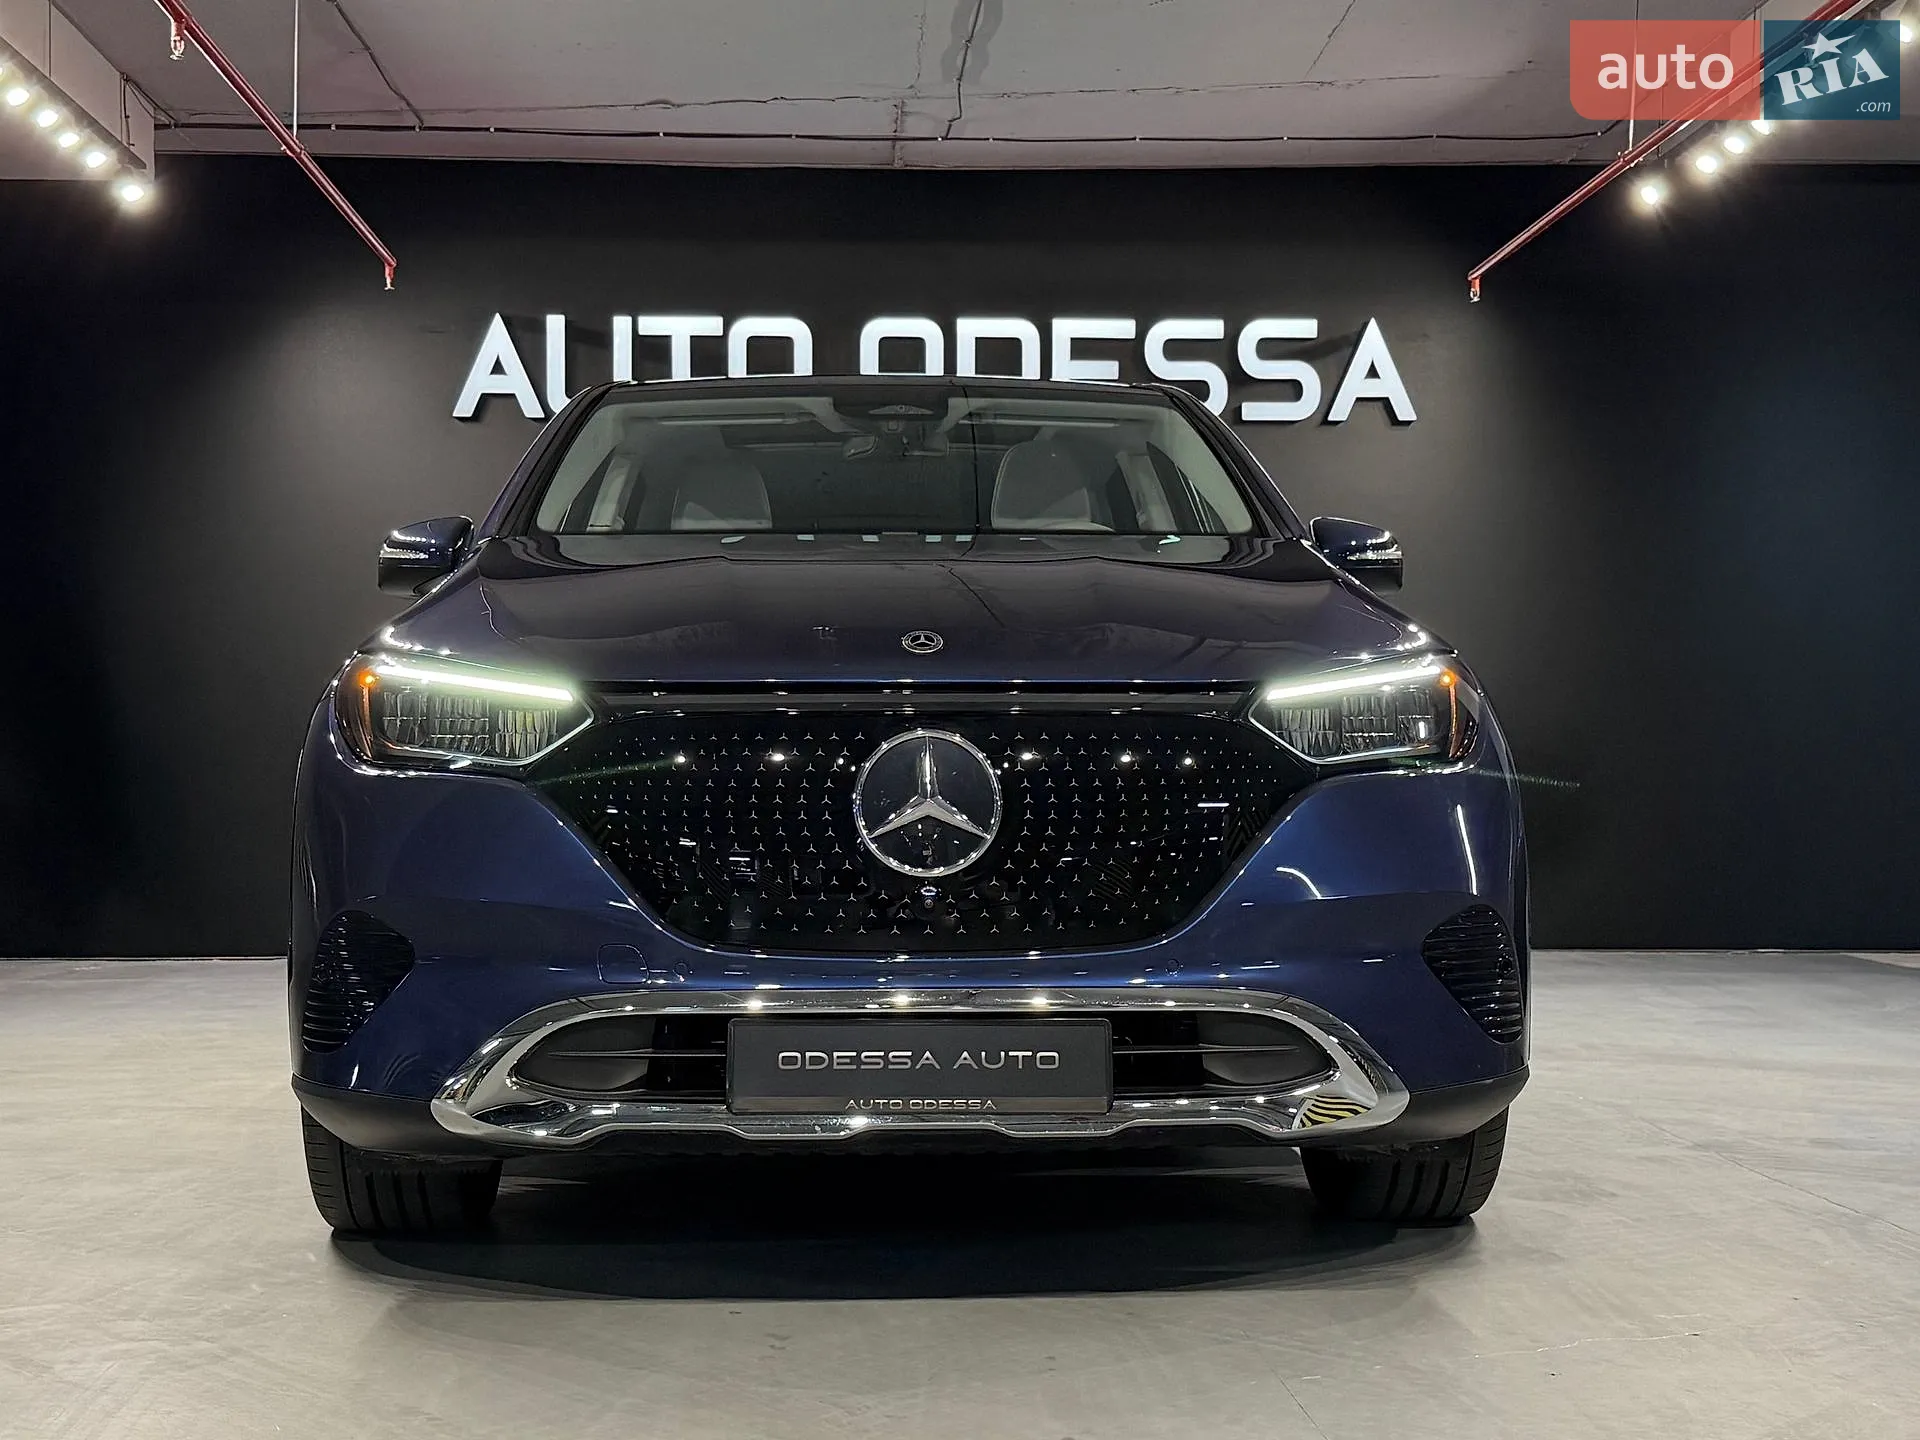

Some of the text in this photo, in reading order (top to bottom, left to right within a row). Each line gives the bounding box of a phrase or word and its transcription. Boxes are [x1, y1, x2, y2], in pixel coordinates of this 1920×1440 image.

[452, 312, 1417, 422] AUTO ODESSA
[778, 1051, 1060, 1070] ODESSA AUTO
[845, 1099, 997, 1111] AUTO ODESSA
